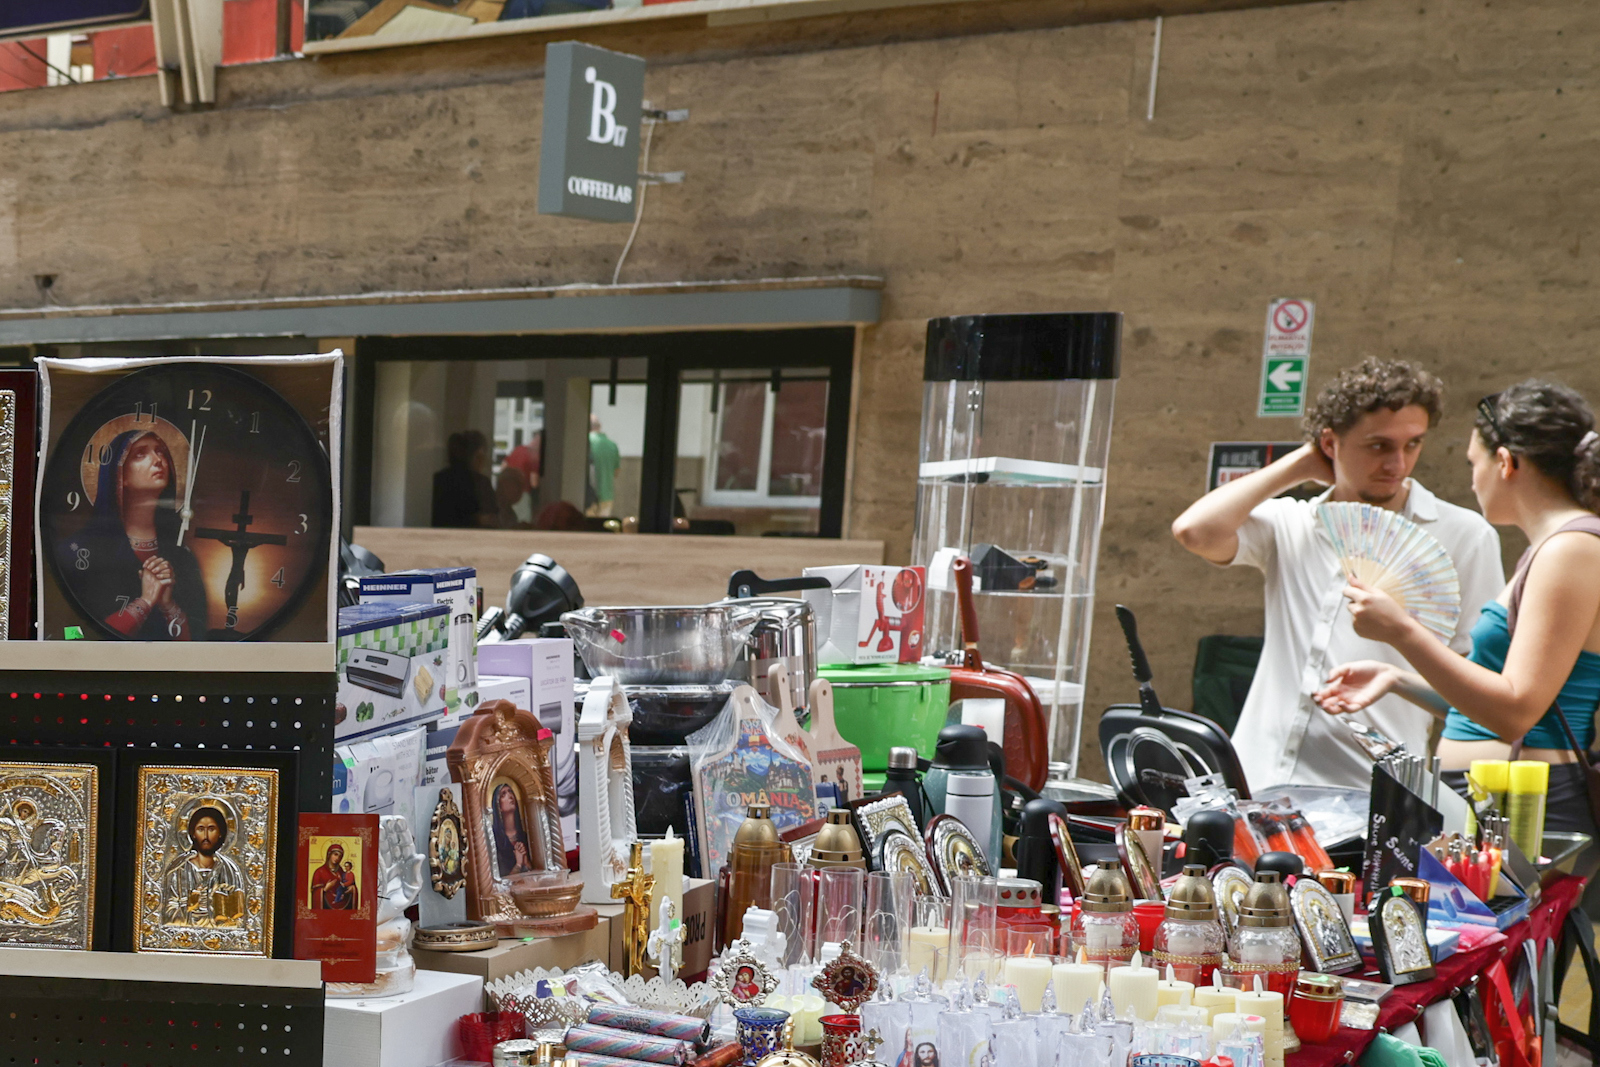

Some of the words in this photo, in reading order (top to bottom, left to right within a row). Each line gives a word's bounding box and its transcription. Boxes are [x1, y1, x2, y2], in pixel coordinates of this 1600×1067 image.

[568, 176, 633, 204] COFFEELAB
[187, 389, 213, 411] 12
[134, 401, 158, 424] 11
[250, 412, 260, 433] 1
[85, 444, 113, 465] 10
[286, 460, 301, 482] 2
[67, 491, 80, 511] 9
[294, 514, 308, 534] 3
[76, 548, 90, 570] 8
[271, 567, 285, 588] 4
[363, 583, 408, 592] HEINNER
[436, 579, 464, 589] HEINNER
[115, 595, 130, 617] 7
[168, 617, 182, 638] 6
[226, 606, 240, 628] 5
[426, 746, 447, 756] INNER
[726, 788, 802, 808] OMÂNIA
